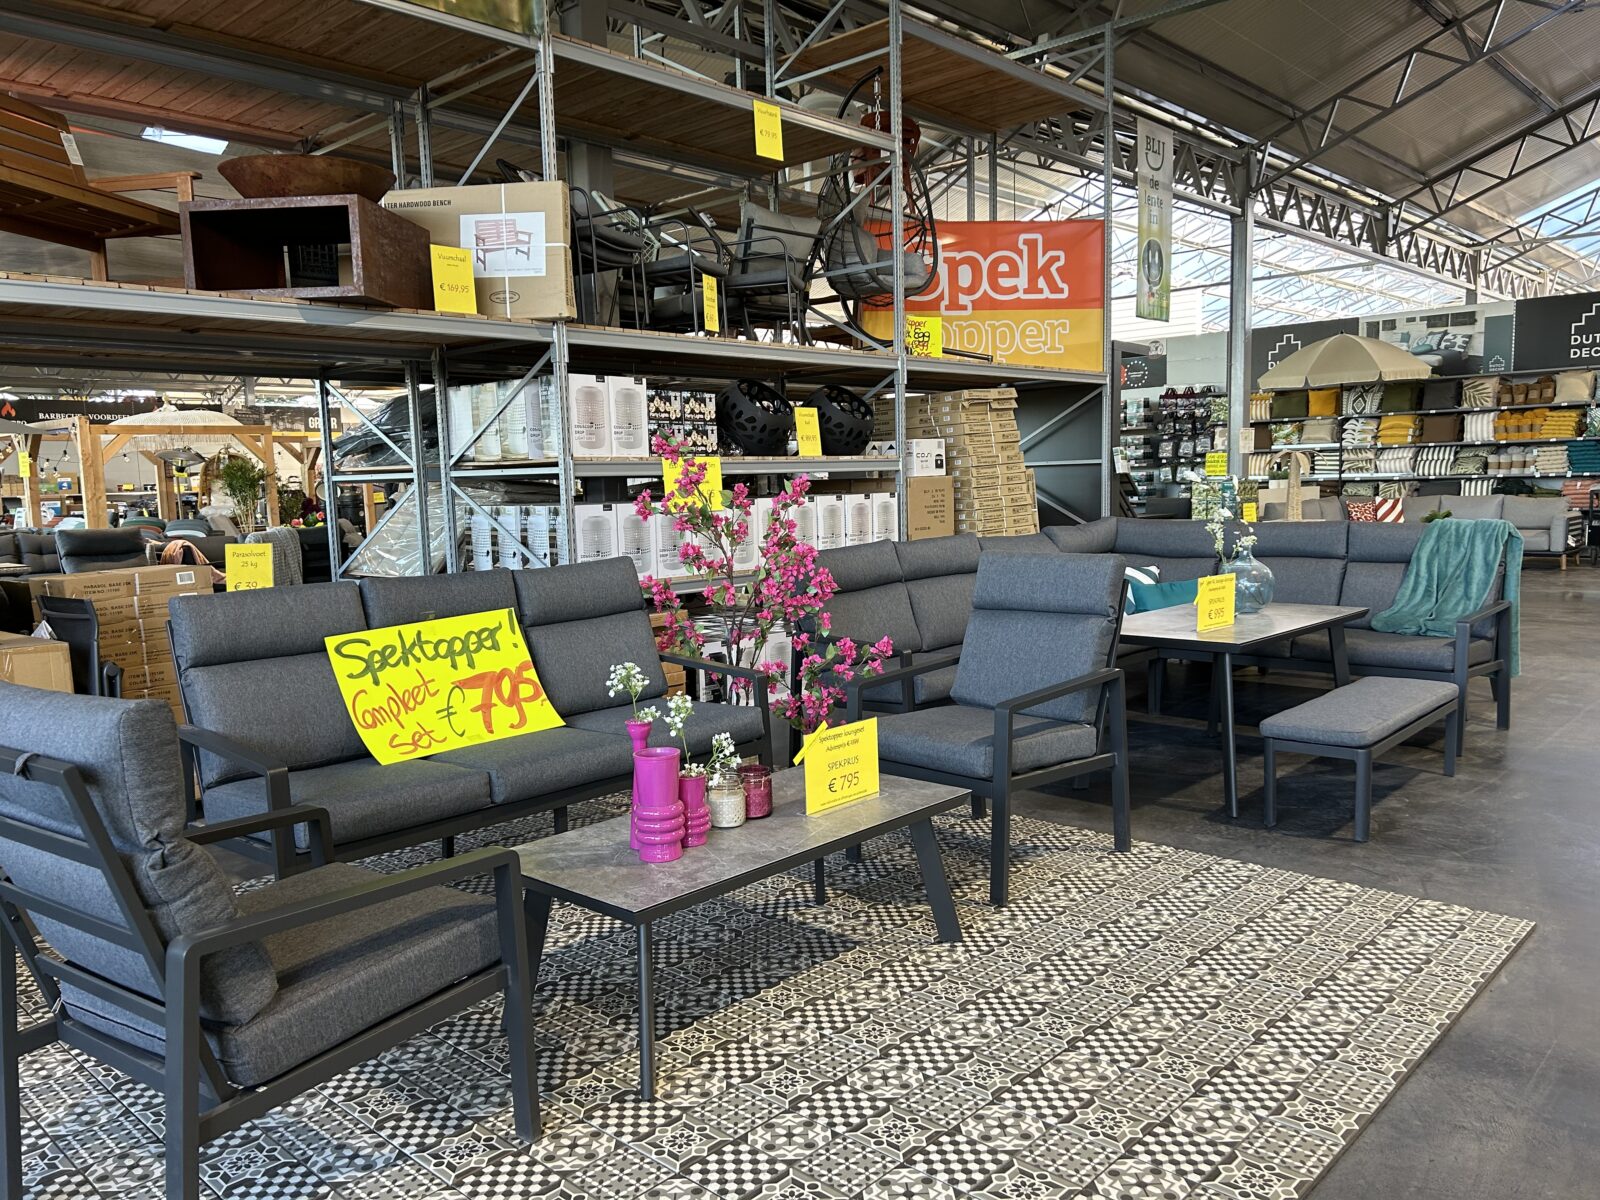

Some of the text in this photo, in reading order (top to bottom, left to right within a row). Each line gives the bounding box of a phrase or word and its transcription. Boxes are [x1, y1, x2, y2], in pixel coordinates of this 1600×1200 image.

[1149, 174, 1160, 190] de
[398, 200, 432, 209] HARDWOOD
[432, 199, 452, 207] BENCH
[1144, 190, 1163, 210] lente
[1150, 209, 1158, 225] in
[439, 282, 470, 294] € 169,95
[232, 550, 266, 558] Parasolvoet
[351, 668, 440, 730] Compleet
[828, 771, 860, 793] € 795
